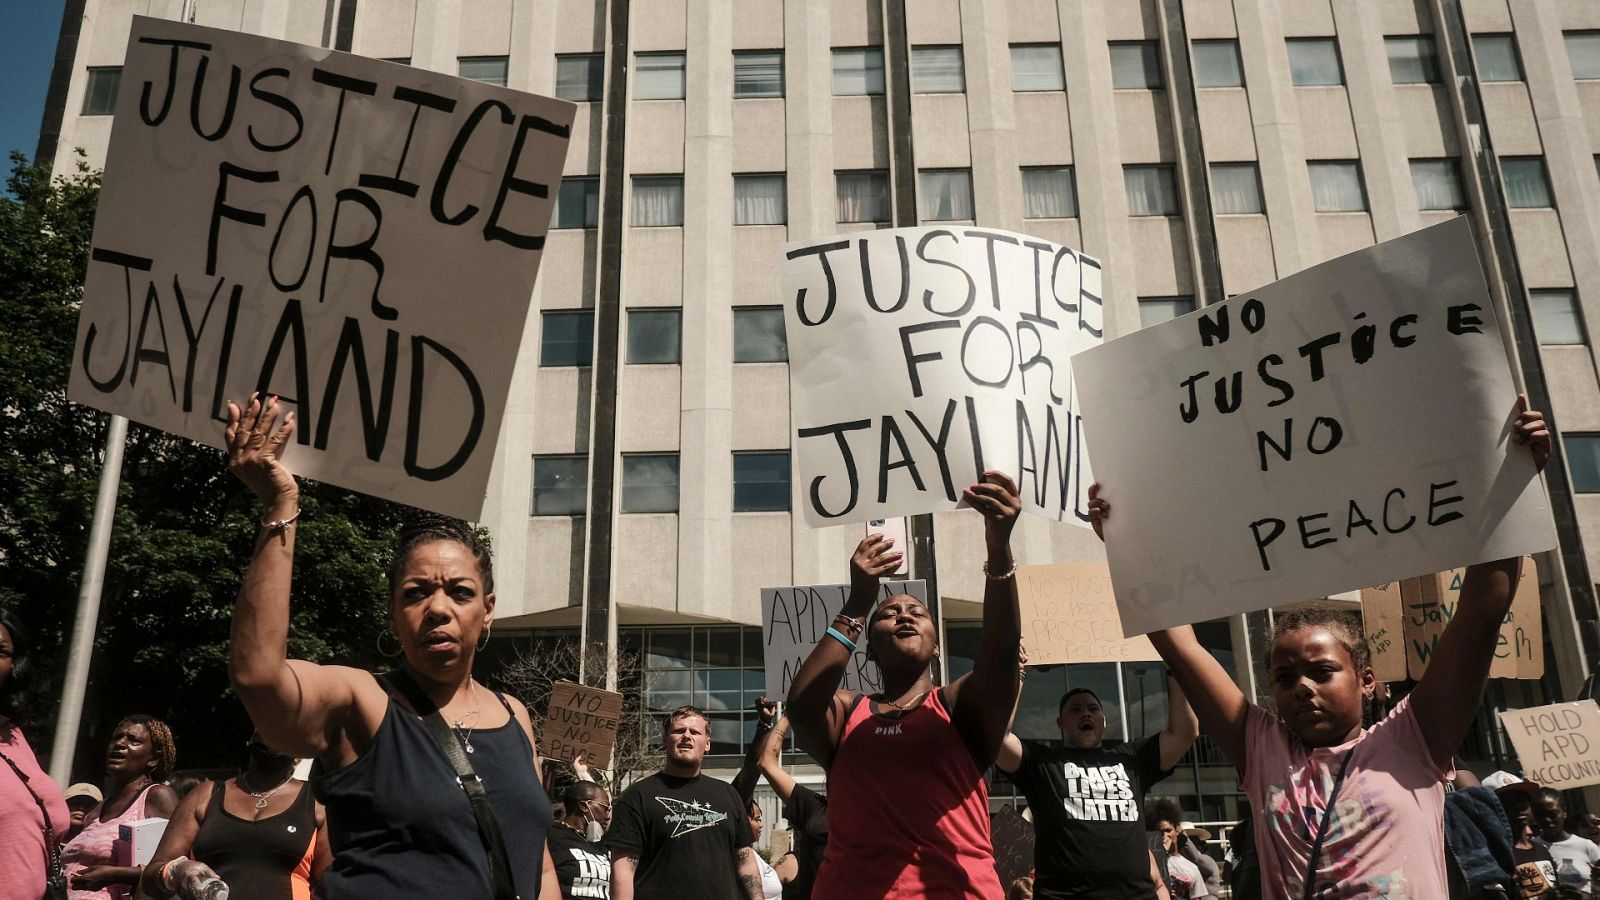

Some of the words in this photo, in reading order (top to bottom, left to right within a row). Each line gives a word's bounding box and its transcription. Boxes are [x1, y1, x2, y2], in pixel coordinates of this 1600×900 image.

[139, 37, 570, 250] JUSTICE
[206, 161, 399, 321] FOR
[787, 230, 1103, 338] JUSTICE
[1198, 298, 1266, 347] NO
[82, 248, 485, 482] JAYLAND
[899, 315, 1063, 405] FOR
[1256, 416, 1343, 471] NO
[1249, 480, 1464, 571] PEACE
[768, 587, 828, 645] APD
[550, 706, 616, 730] JUSTICE
[568, 691, 602, 712] NO
[563, 727, 590, 743] NO
[875, 723, 902, 735] PINK
[1520, 709, 1582, 737] HOLD
[1542, 732, 1589, 762] APD
[1064, 762, 1129, 781] BLACK
[1068, 779, 1133, 800] LIVES
[1064, 798, 1138, 821] MATTER
